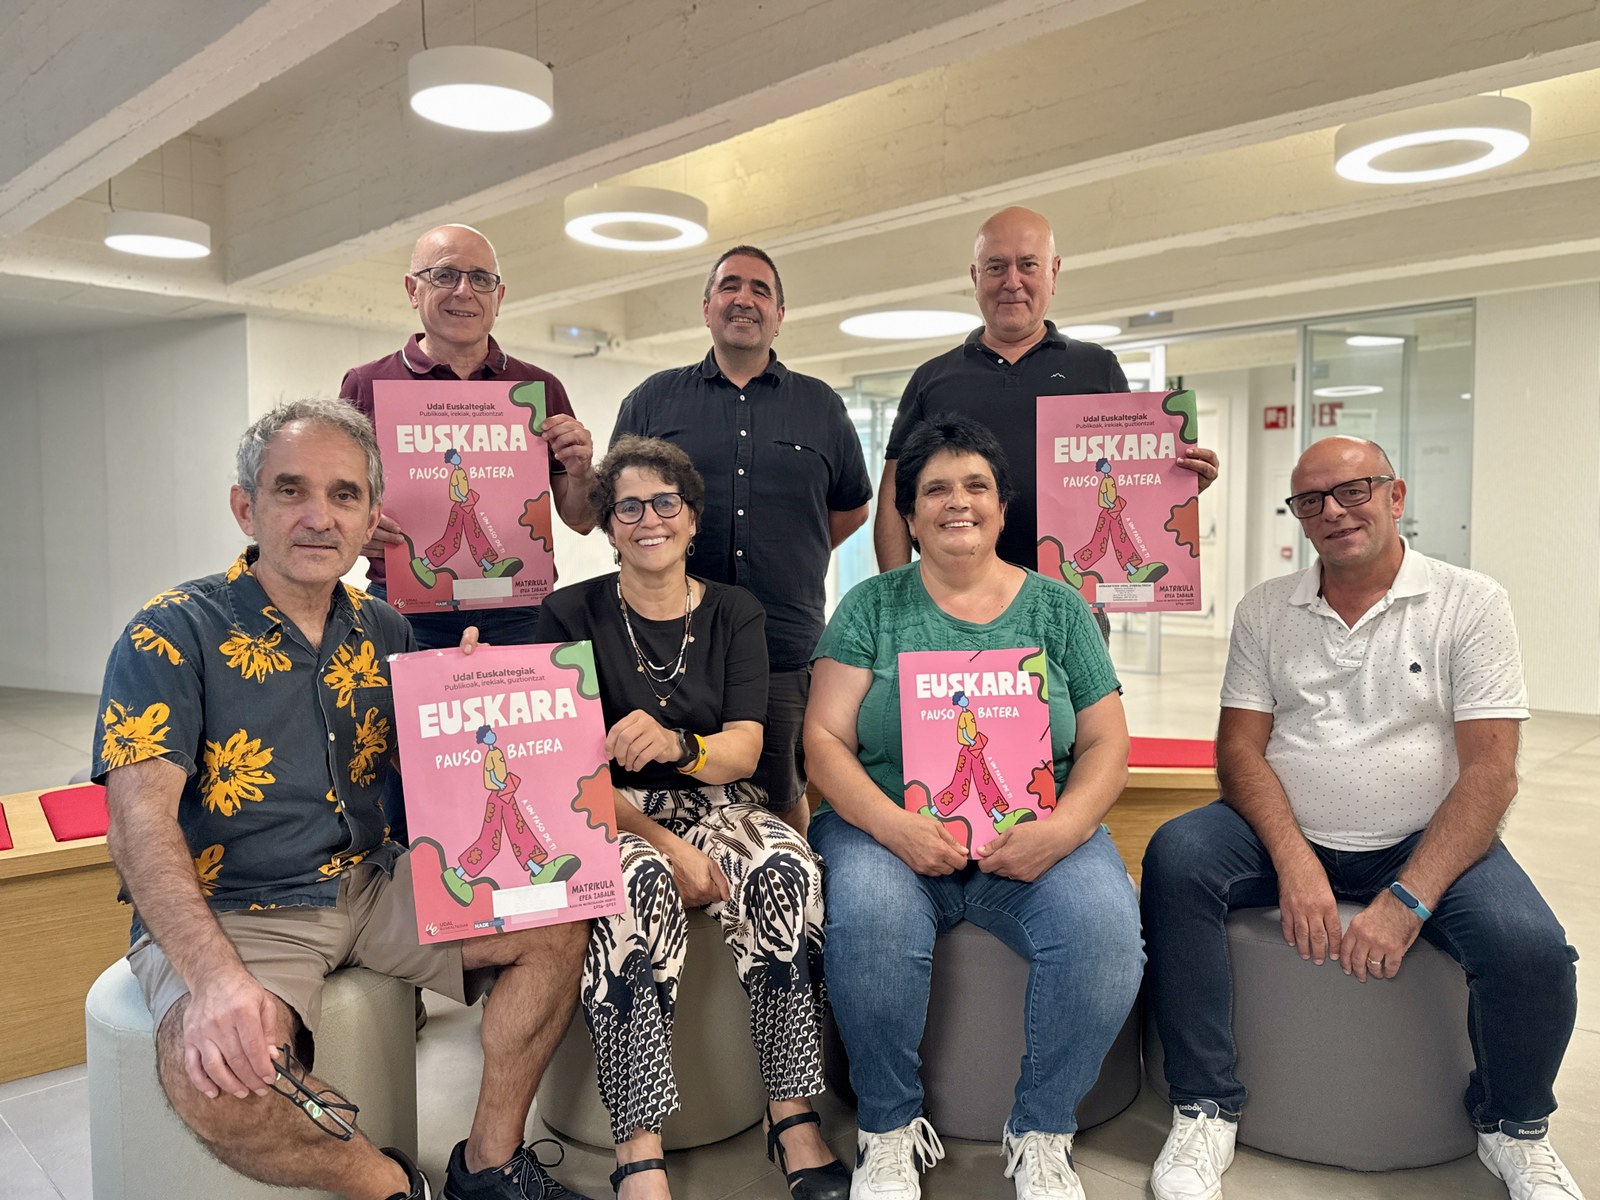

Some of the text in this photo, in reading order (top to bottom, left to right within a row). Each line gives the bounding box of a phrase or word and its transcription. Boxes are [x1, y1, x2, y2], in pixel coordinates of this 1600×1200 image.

[446, 403, 496, 412] Euskaltegiak
[1101, 414, 1148, 422] Euskaltegiak
[396, 424, 528, 454] EUSKARA
[1054, 432, 1176, 463] EUSKARA
[409, 466, 515, 480] PAUSO BATERA
[1063, 473, 1162, 488] PAUSO BATERA
[515, 579, 548, 588] MATRIKULA
[452, 667, 536, 683] Udal Euskaltegiak
[444, 675, 546, 692] Publikoak, irekiak, guztiontzat
[916, 670, 1034, 699] EUSKARA
[418, 687, 578, 739] EUSKARA
[921, 706, 1020, 721] PAUSO BATERA
[435, 738, 563, 769] PAUSO BATERA
[572, 880, 615, 894] MATRIKULA
[593, 890, 615, 899] ZABALIK
